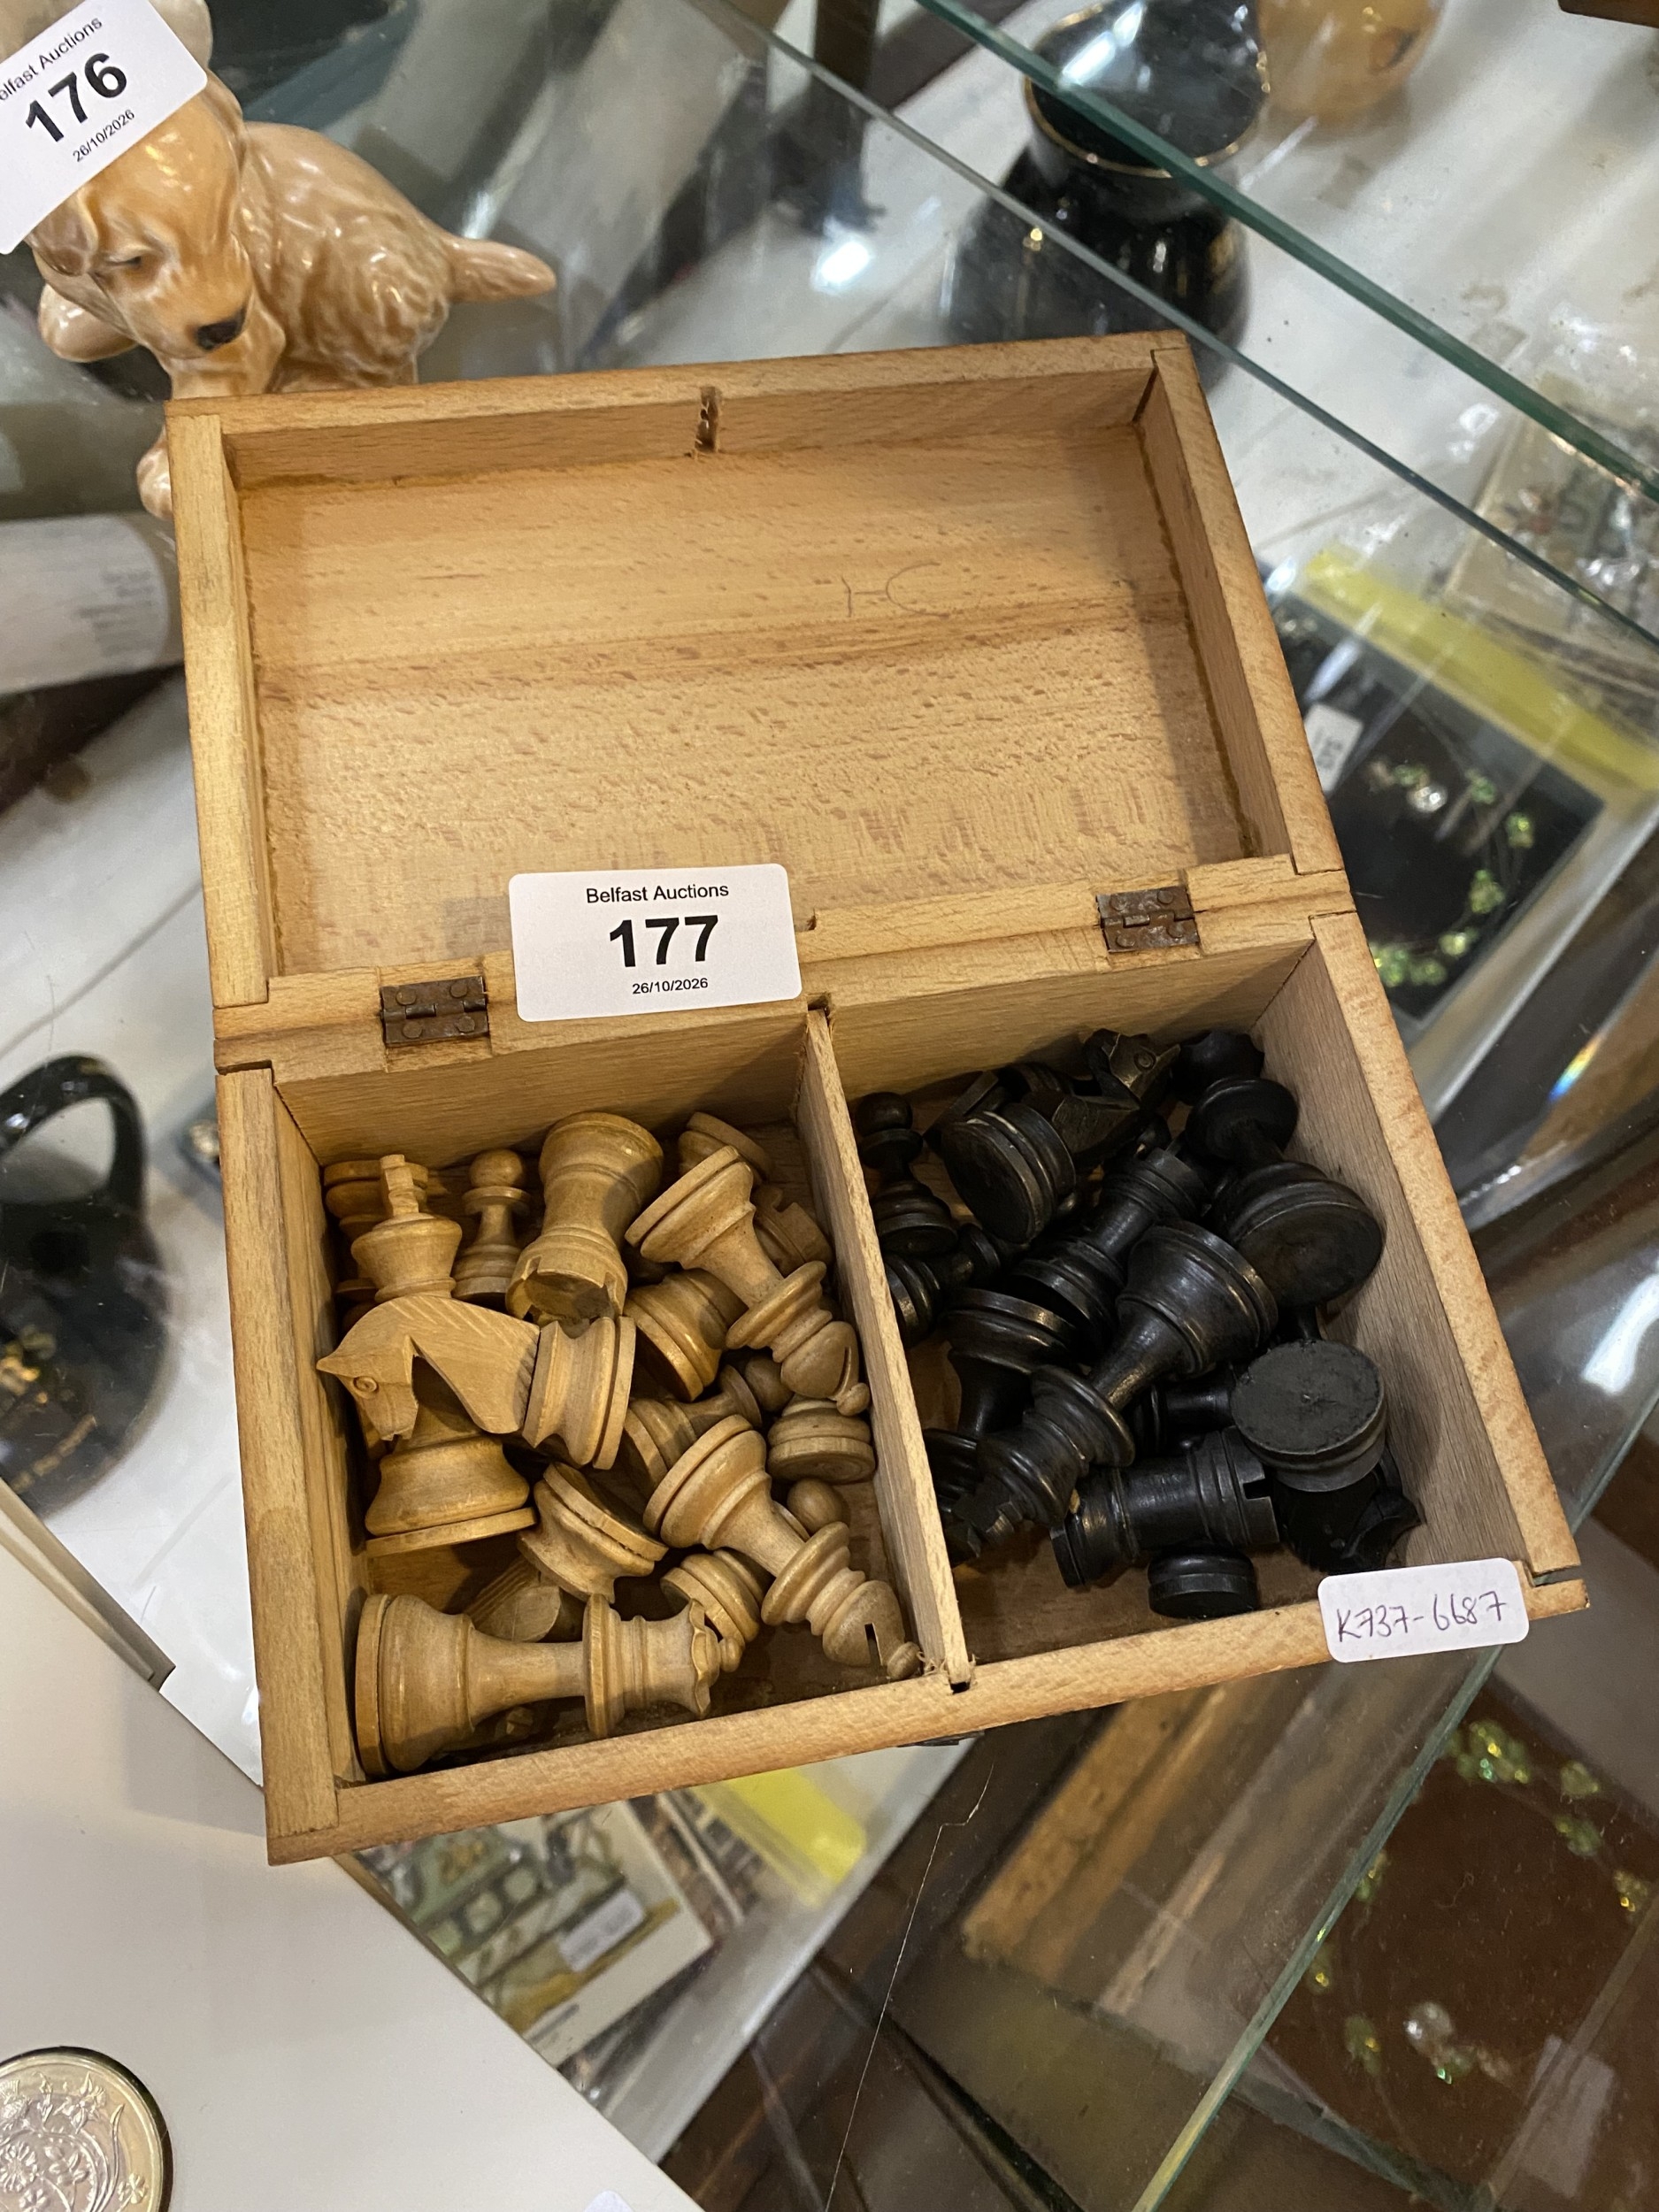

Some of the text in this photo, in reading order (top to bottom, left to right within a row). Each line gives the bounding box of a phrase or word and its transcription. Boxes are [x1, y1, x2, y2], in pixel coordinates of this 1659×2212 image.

[0, 18, 103, 101] elfast Auctions
[25, 52, 127, 142] 176
[73, 109, 135, 162] 26/10/2026
[586, 883, 729, 903] Belfast Auctions
[609, 914, 718, 968] 177
[632, 977, 709, 995] 26/10/2026
